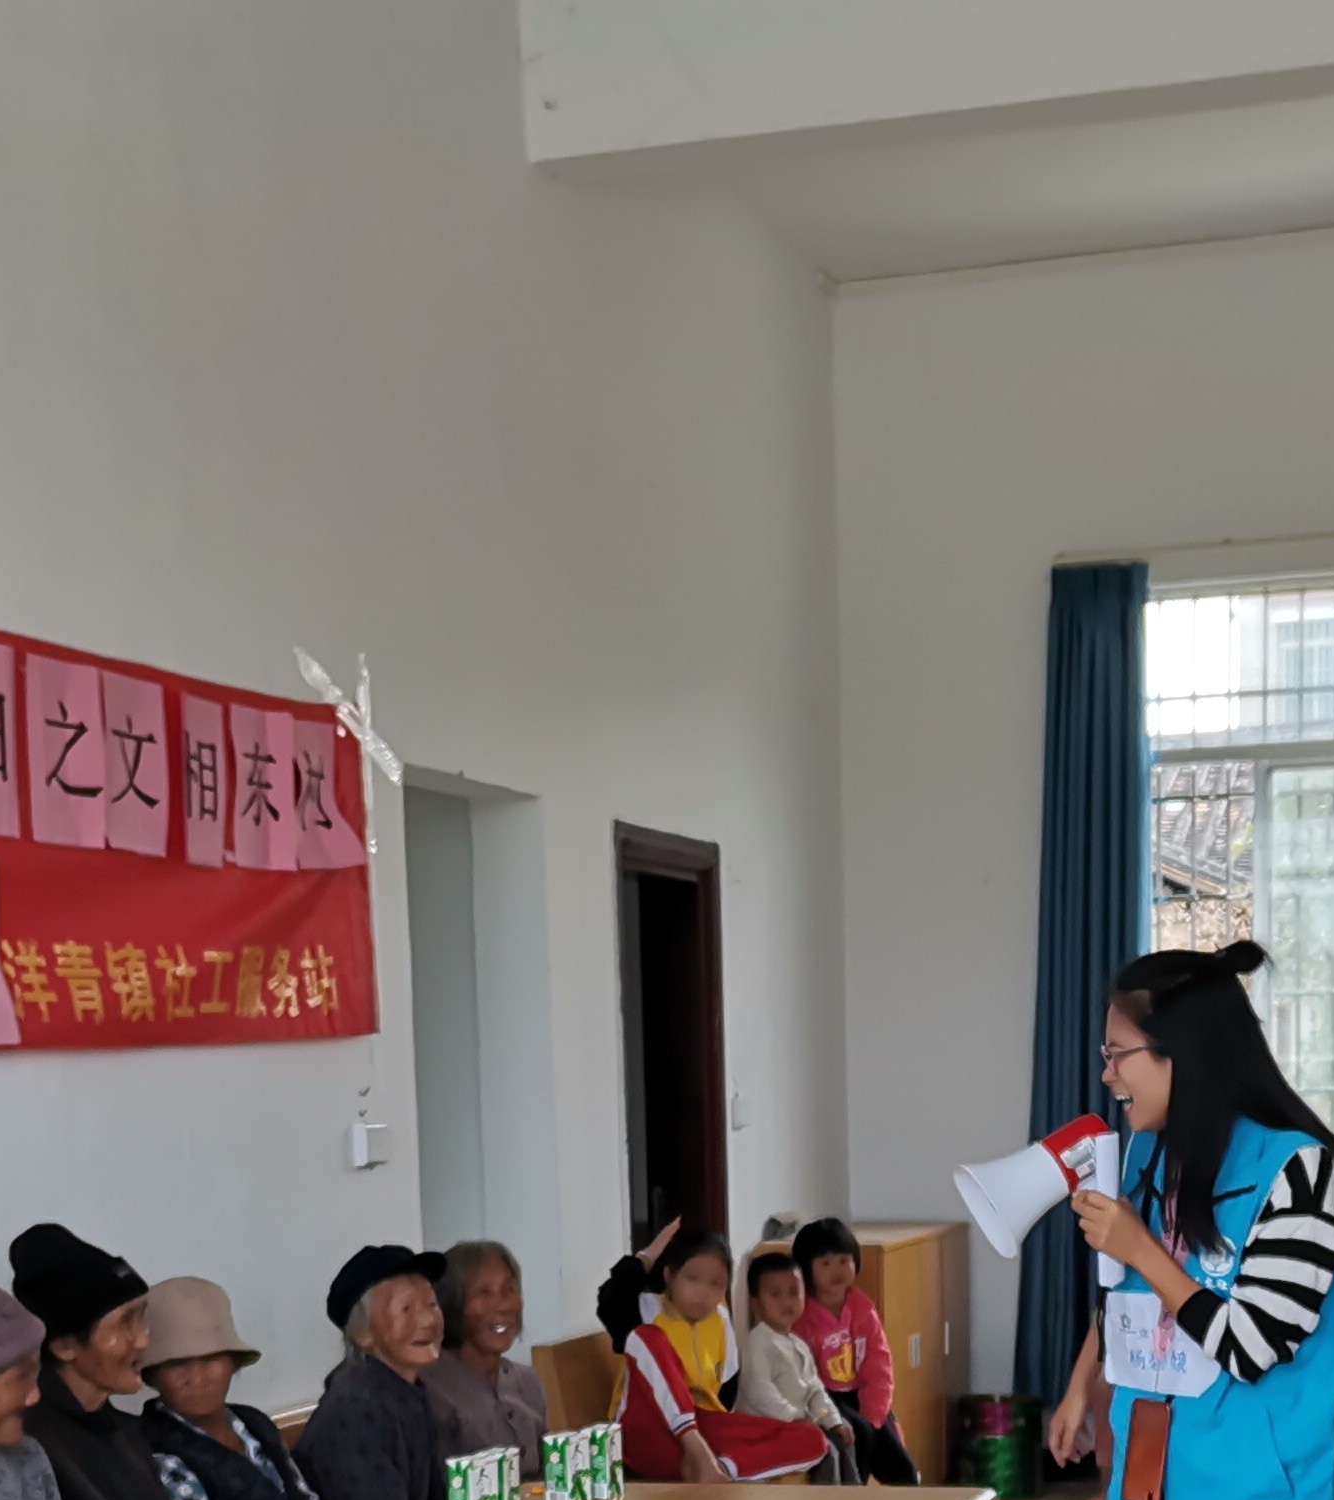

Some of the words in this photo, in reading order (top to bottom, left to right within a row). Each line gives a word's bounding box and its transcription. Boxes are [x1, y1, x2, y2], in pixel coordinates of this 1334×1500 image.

[1, 940, 339, 1024] 洋青镇社工服务站
